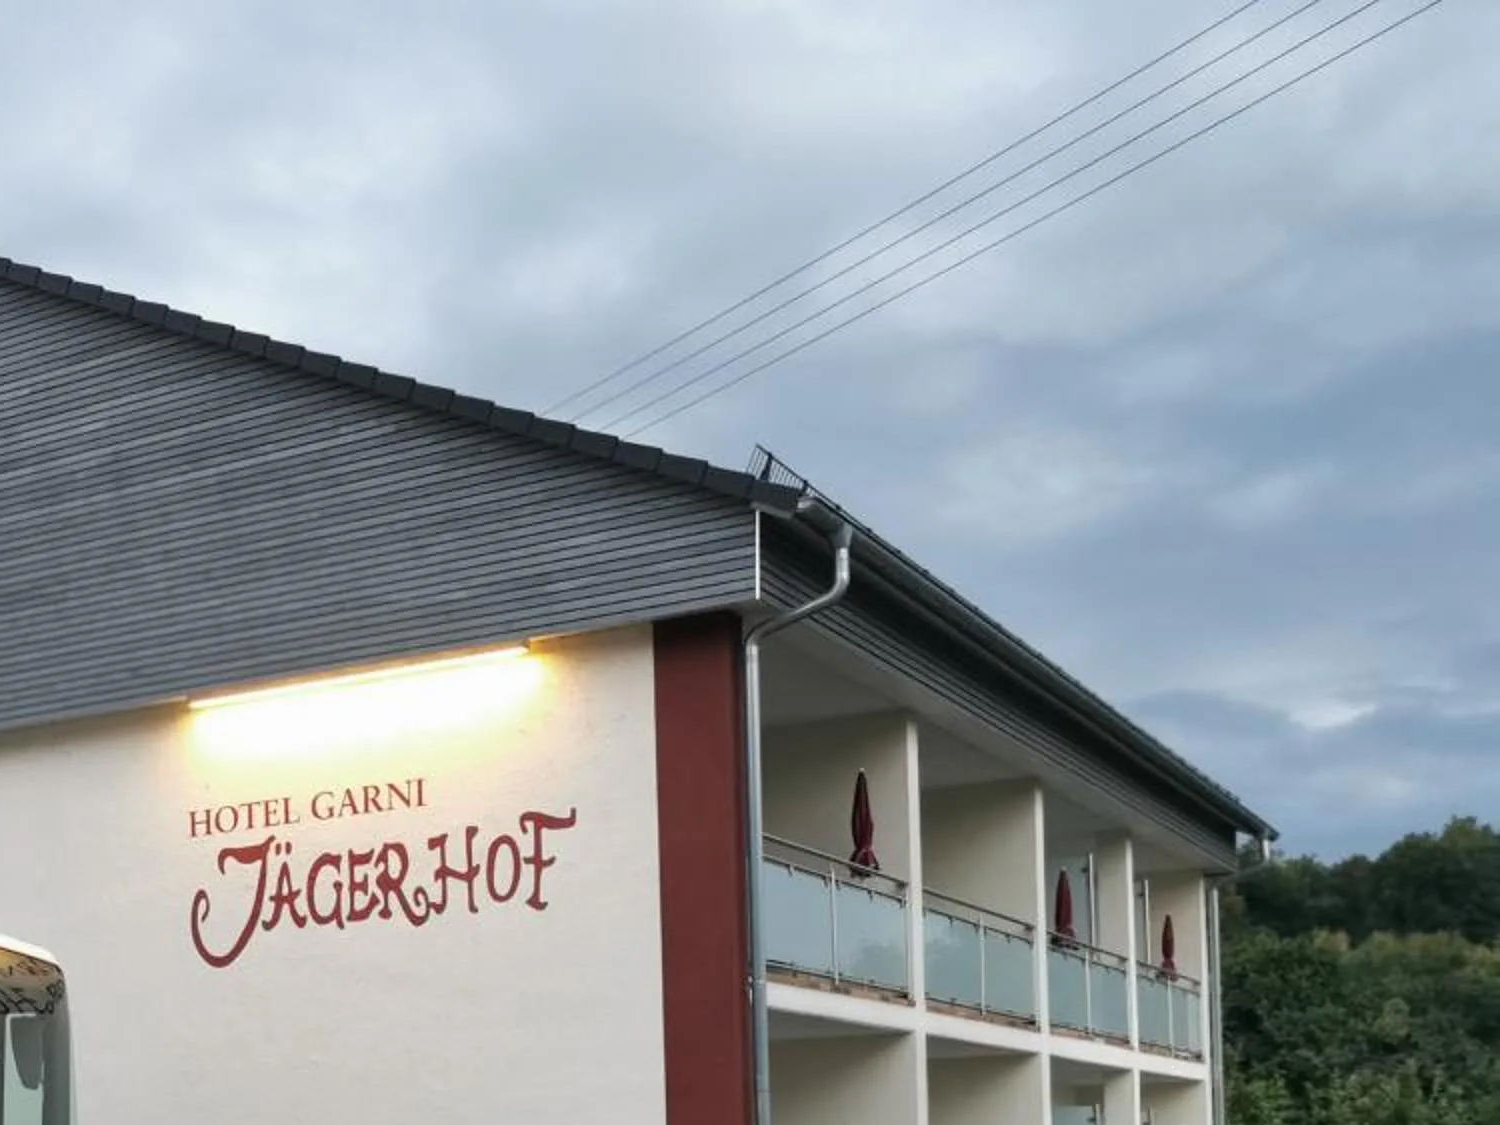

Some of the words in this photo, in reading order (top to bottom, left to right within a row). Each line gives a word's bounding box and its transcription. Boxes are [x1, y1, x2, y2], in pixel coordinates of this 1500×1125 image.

[188, 797, 301, 838] HOTEL
[310, 778, 428, 821] GARNI
[190, 807, 577, 969] JÄGERHOF
